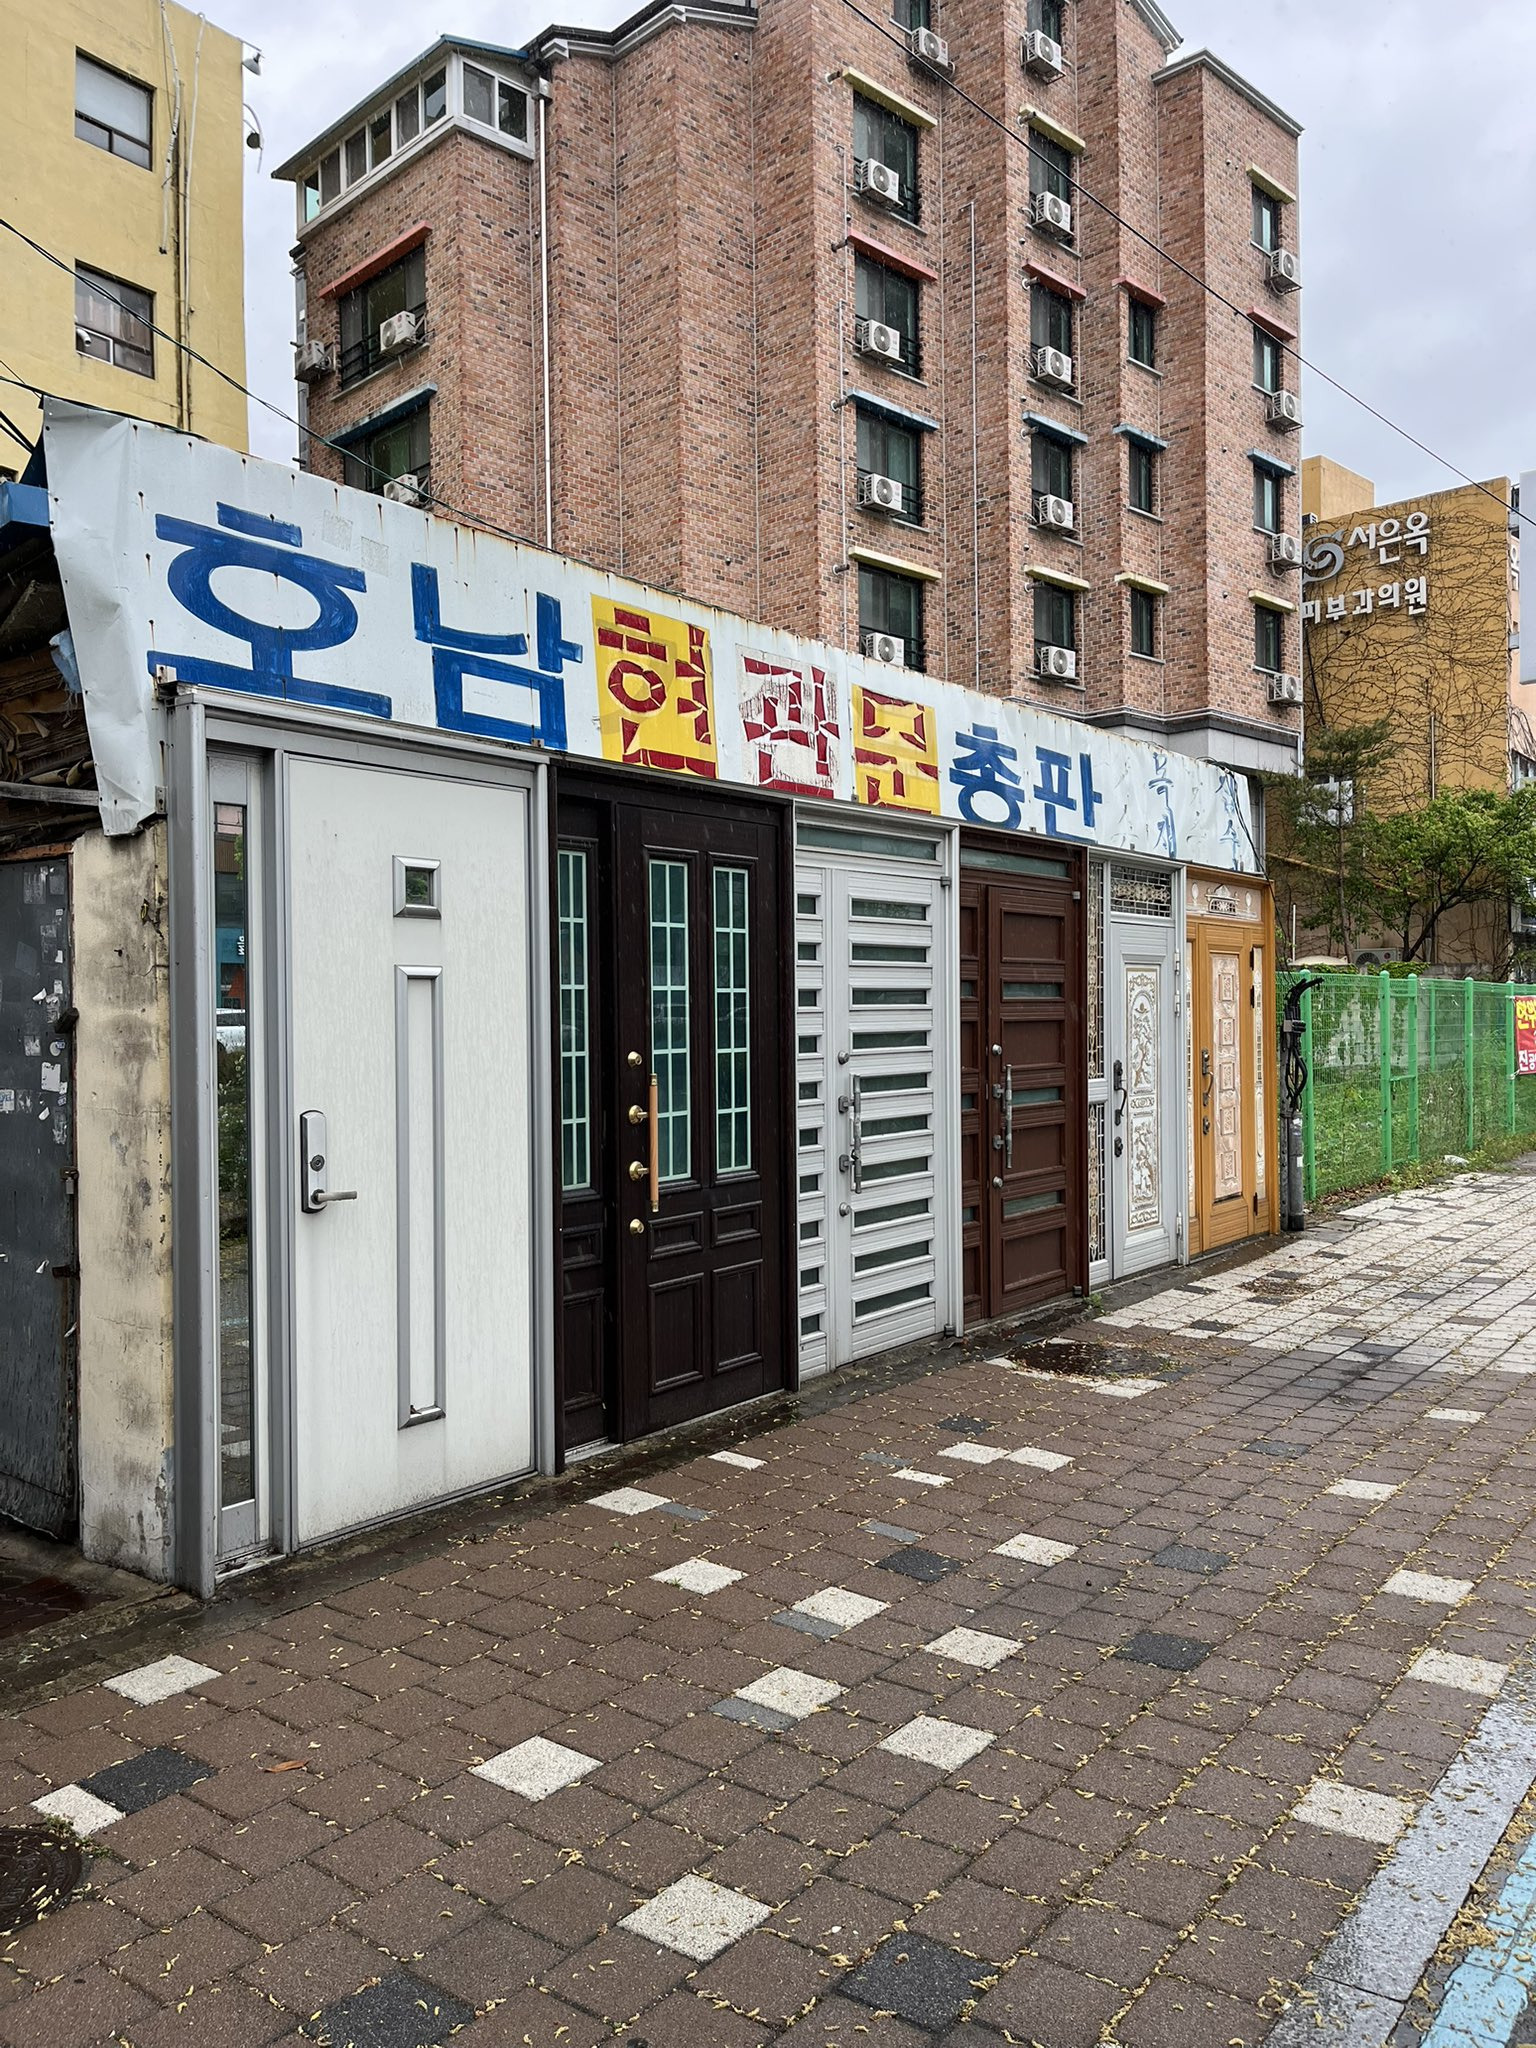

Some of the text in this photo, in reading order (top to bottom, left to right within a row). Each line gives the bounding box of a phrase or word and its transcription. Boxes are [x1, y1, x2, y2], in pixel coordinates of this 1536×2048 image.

[1347, 511, 1430, 565] 서은옥
[1302, 576, 1428, 625] 피부과의원
[147, 501, 583, 750] 호남
[598, 607, 939, 815] 현관문
[949, 723, 1103, 845] 총판
